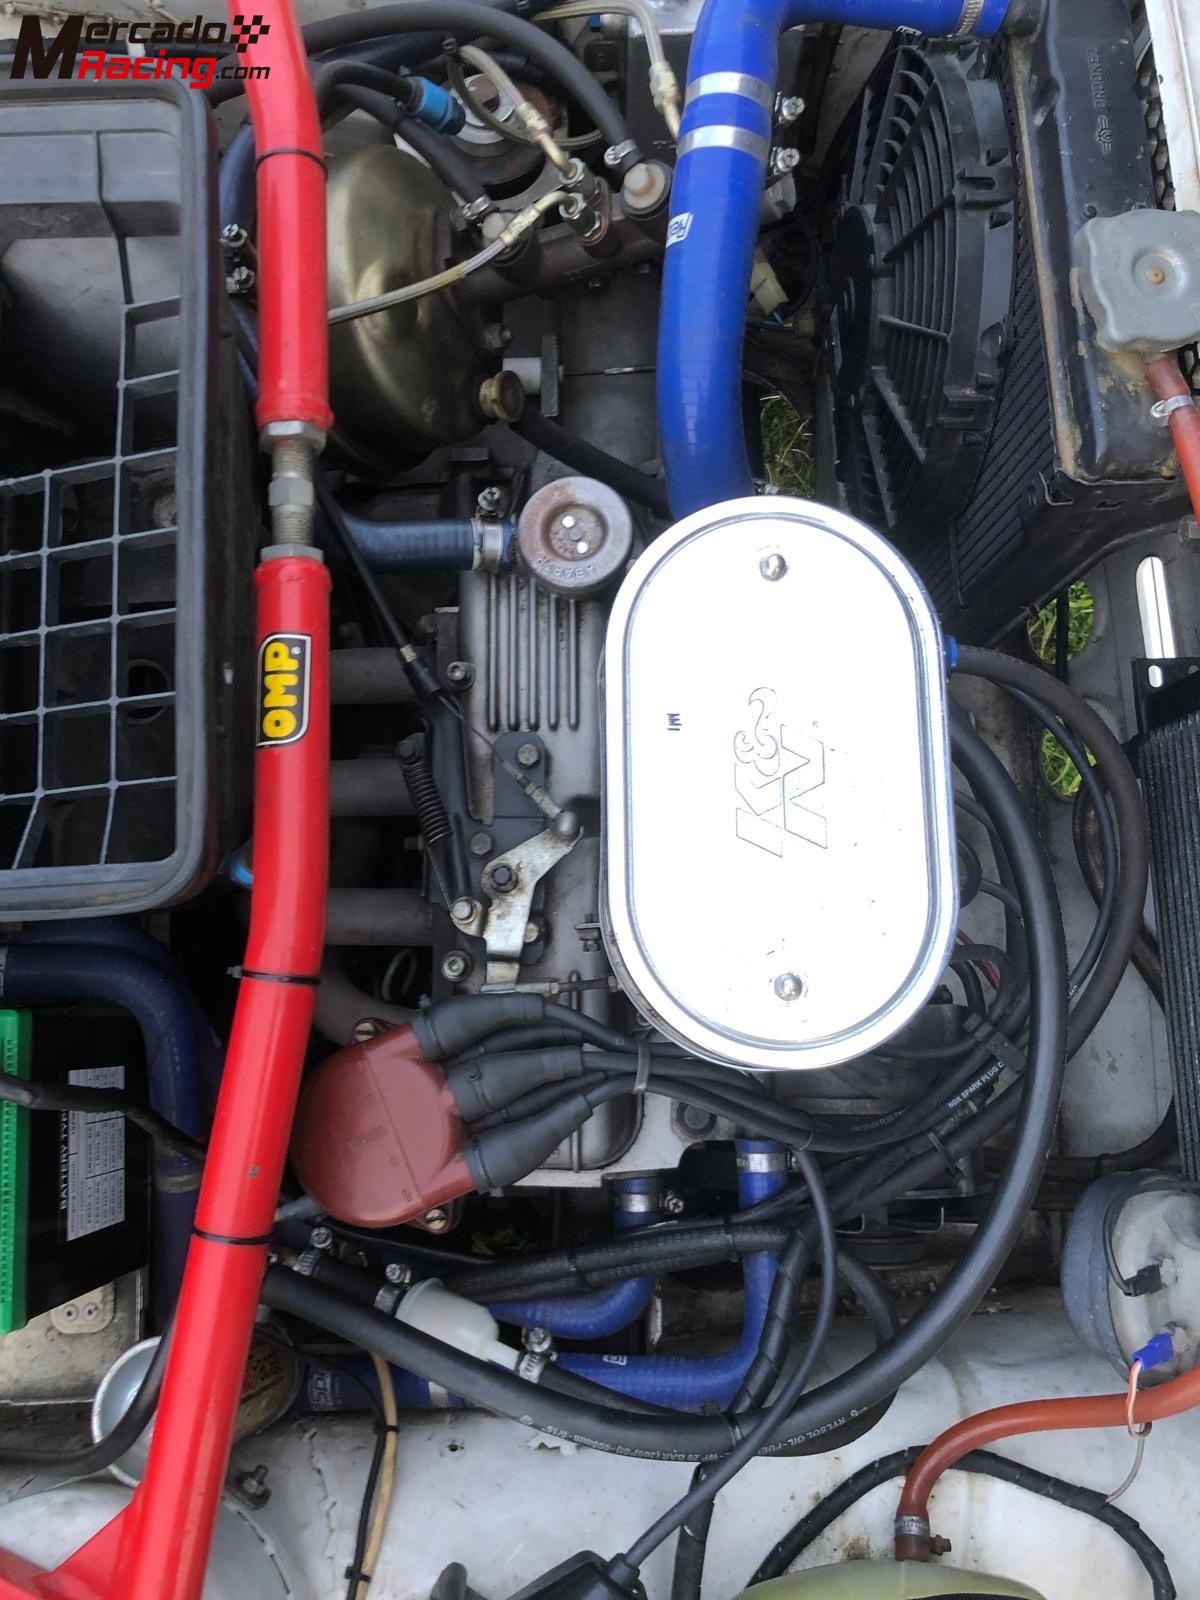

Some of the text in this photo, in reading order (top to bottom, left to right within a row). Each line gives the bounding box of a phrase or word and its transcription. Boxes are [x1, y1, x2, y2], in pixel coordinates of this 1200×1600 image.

[262, 641, 300, 738] OMP
[960, 1079, 983, 1100] SPARK
[980, 1066, 999, 1083] PLUG
